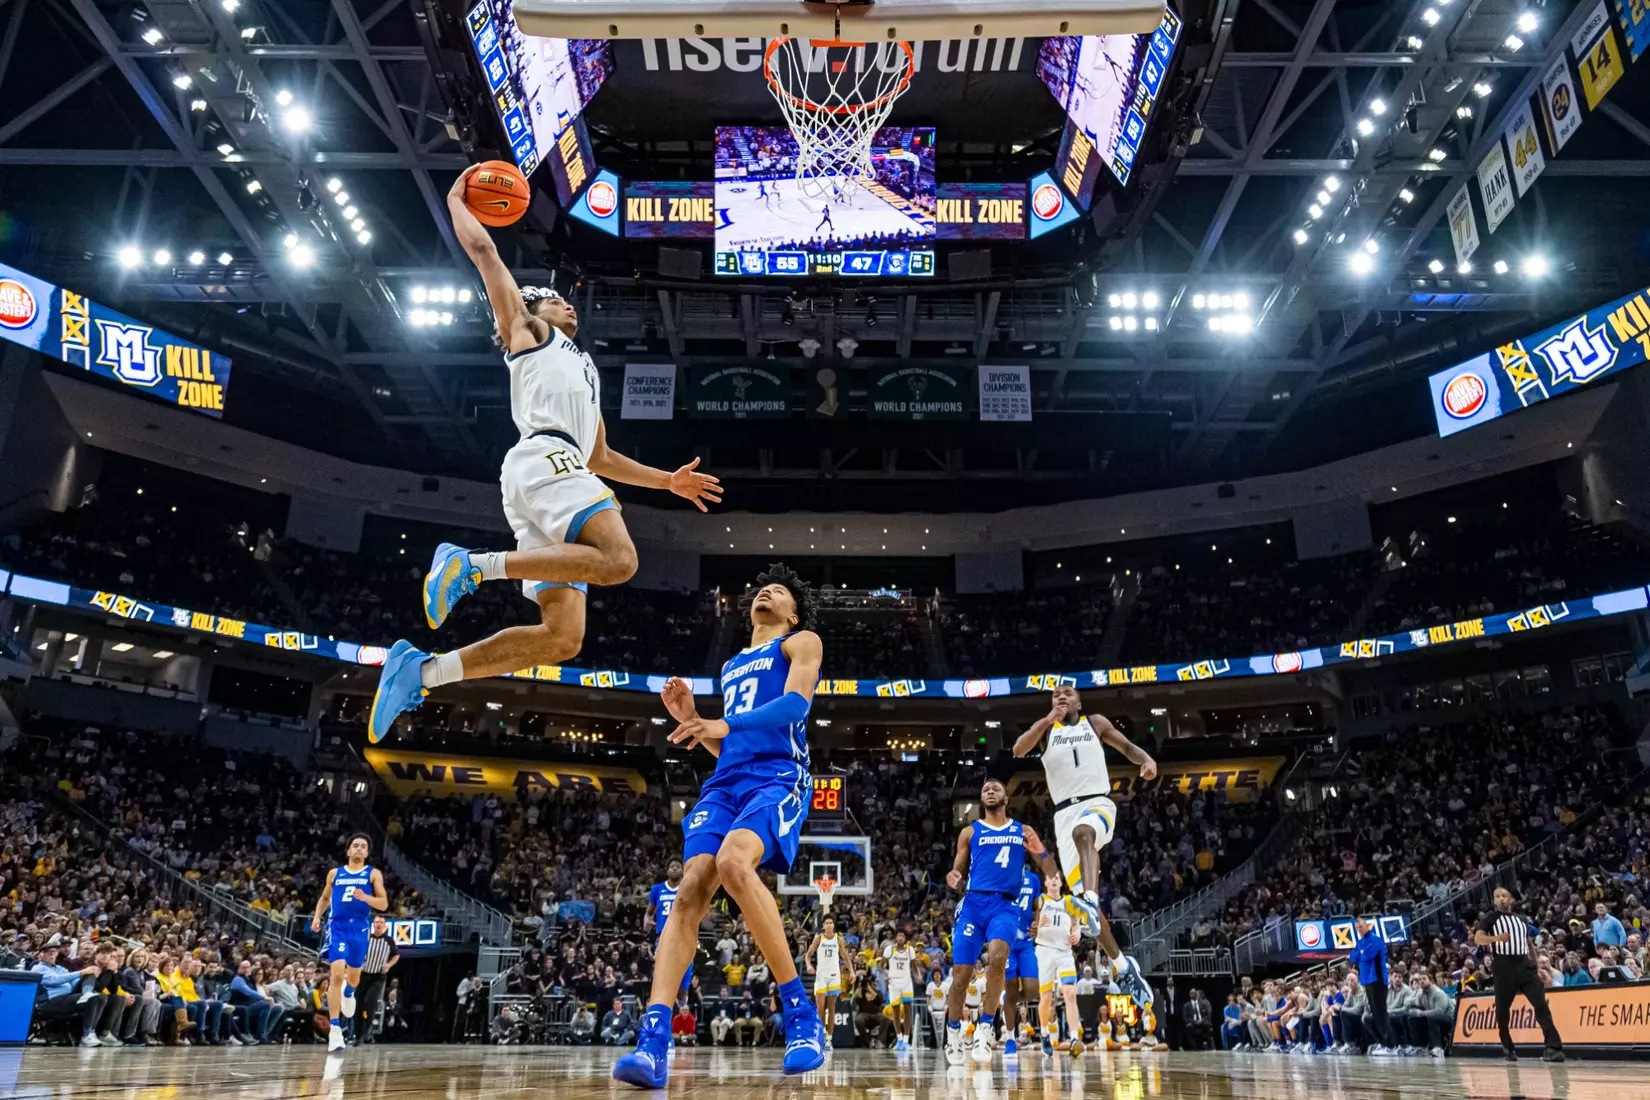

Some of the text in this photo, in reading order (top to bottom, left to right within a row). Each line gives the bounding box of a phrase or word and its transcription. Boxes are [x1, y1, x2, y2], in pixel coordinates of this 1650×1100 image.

[1586, 40, 1612, 83] 14
[1145, 61, 1159, 85] 47
[502, 79, 517, 108] 11:10
[1552, 85, 1570, 118] 24
[509, 116, 522, 134] 47
[1127, 119, 1140, 140] 55
[1514, 125, 1538, 168] 44
[557, 125, 587, 194] KILL ZONE
[1063, 128, 1092, 197] KILL ZONE
[478, 171, 515, 189] ELITE
[1484, 165, 1507, 205] HANK
[627, 198, 714, 222] KILL ZONE
[936, 199, 973, 223] KILL
[977, 199, 1023, 223] ZONE
[776, 257, 799, 270] 55
[808, 254, 841, 264] 11:10
[851, 257, 872, 271] 47
[95, 319, 163, 386] MU
[1533, 315, 1619, 386] MU
[165, 345, 215, 382] KILL
[627, 376, 673, 386] CONFERENCE
[983, 383, 1027, 392] CHAMPIONS
[988, 373, 1021, 382] DIVISION
[177, 380, 224, 409] ZONE
[628, 386, 671, 395] CHAMPIONS
[1448, 380, 1475, 404] DAVE
[697, 401, 786, 411] WORLD CHAMPIONS
[874, 402, 963, 412] WORLD CHAMPIONS
[191, 612, 215, 632] KILL
[215, 617, 246, 638] ZONE
[1428, 624, 1454, 644] KILL
[1455, 618, 1485, 639] ZONE
[535, 665, 562, 681] ZONE
[1108, 668, 1130, 684] KILL
[1131, 665, 1157, 682] ZONE
[724, 677, 759, 718] 23
[815, 680, 858, 694] ILL ZONE
[1072, 746, 1081, 769] 1
[387, 761, 634, 795] WE ARE
[813, 778, 842, 790] 11:10
[1013, 768, 1261, 799] MQUETTE
[813, 790, 839, 810] 28
[978, 836, 1024, 846] CREIGHTON
[994, 846, 1011, 868] 4
[341, 886, 357, 902] 2
[1053, 914, 1061, 926] 11
[824, 949, 833, 958] 13
[896, 961, 905, 970] 12
[1462, 1003, 1540, 1038] Contintal
[1579, 1004, 1607, 1027] THE
